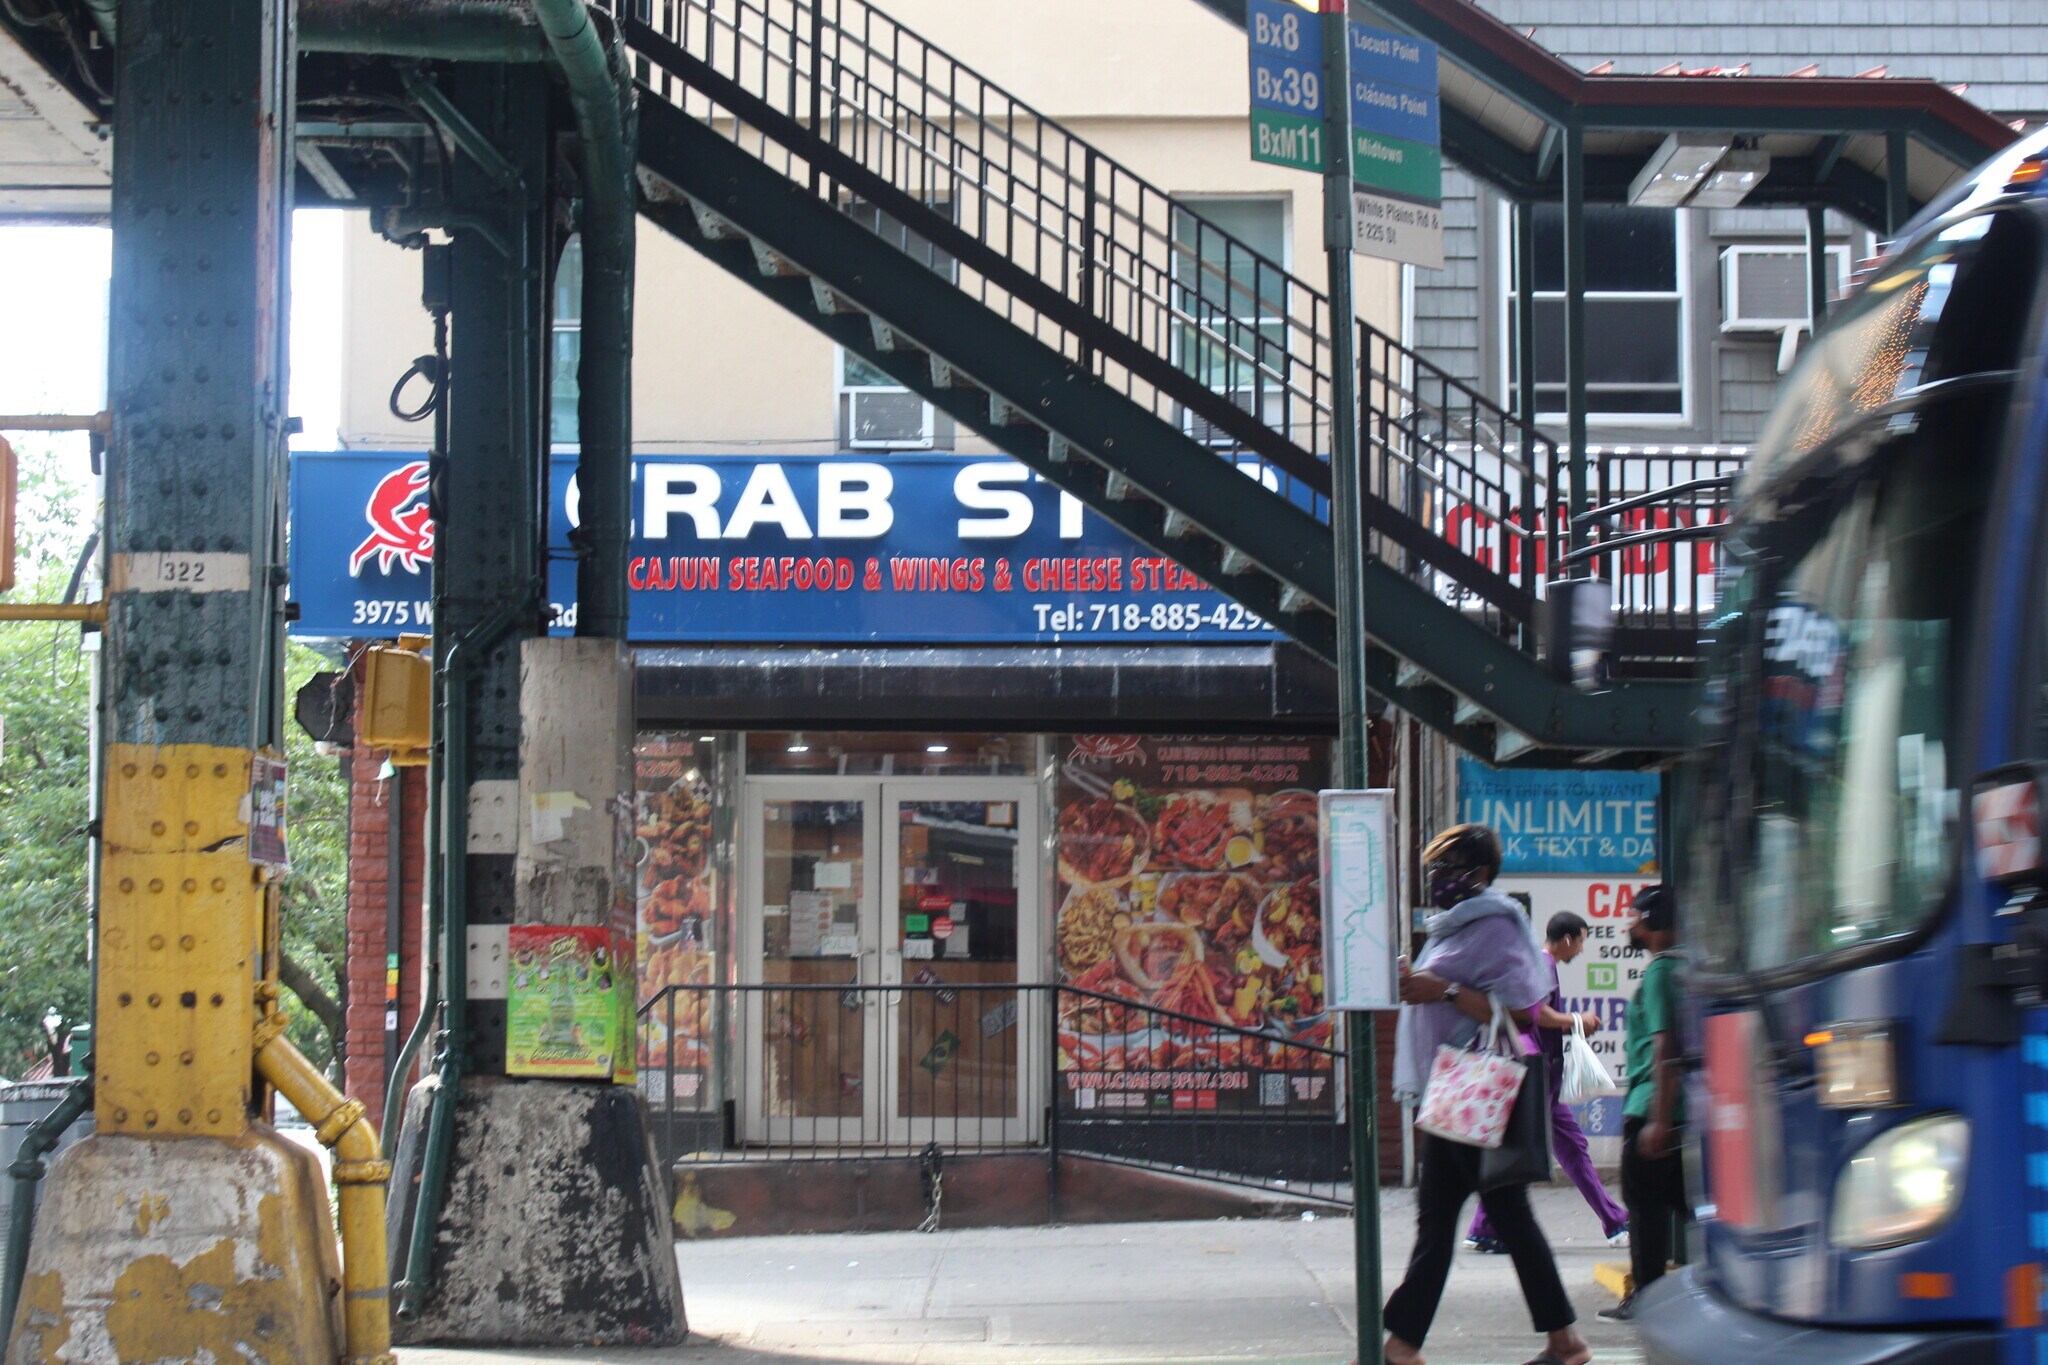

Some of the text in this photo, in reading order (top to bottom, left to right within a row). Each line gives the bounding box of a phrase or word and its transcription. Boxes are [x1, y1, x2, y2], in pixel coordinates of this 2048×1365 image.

[1255, 12, 1299, 51] Bx8
[1354, 29, 1420, 63] Locust Point
[1257, 67, 1319, 111] Bx39
[1400, 94, 1428, 117] Point
[1258, 122, 1321, 165] BxM11
[1358, 137, 1403, 164] Midtown
[1356, 197, 1439, 230] White Plains Rd &
[1357, 221, 1364, 238] E
[1366, 223, 1384, 242] 225
[164, 561, 205, 582] 322
[628, 556, 1210, 592] CAJUN SEAFOOD & WINGS & CHEESE STEA
[352, 600, 409, 625] 3975
[1033, 603, 1084, 631] Tel:
[1565, 783, 1594, 797] YOU
[1464, 799, 1657, 834] UNLIMITE
[1534, 837, 1593, 857] TEXT
[1599, 837, 1616, 857] &
